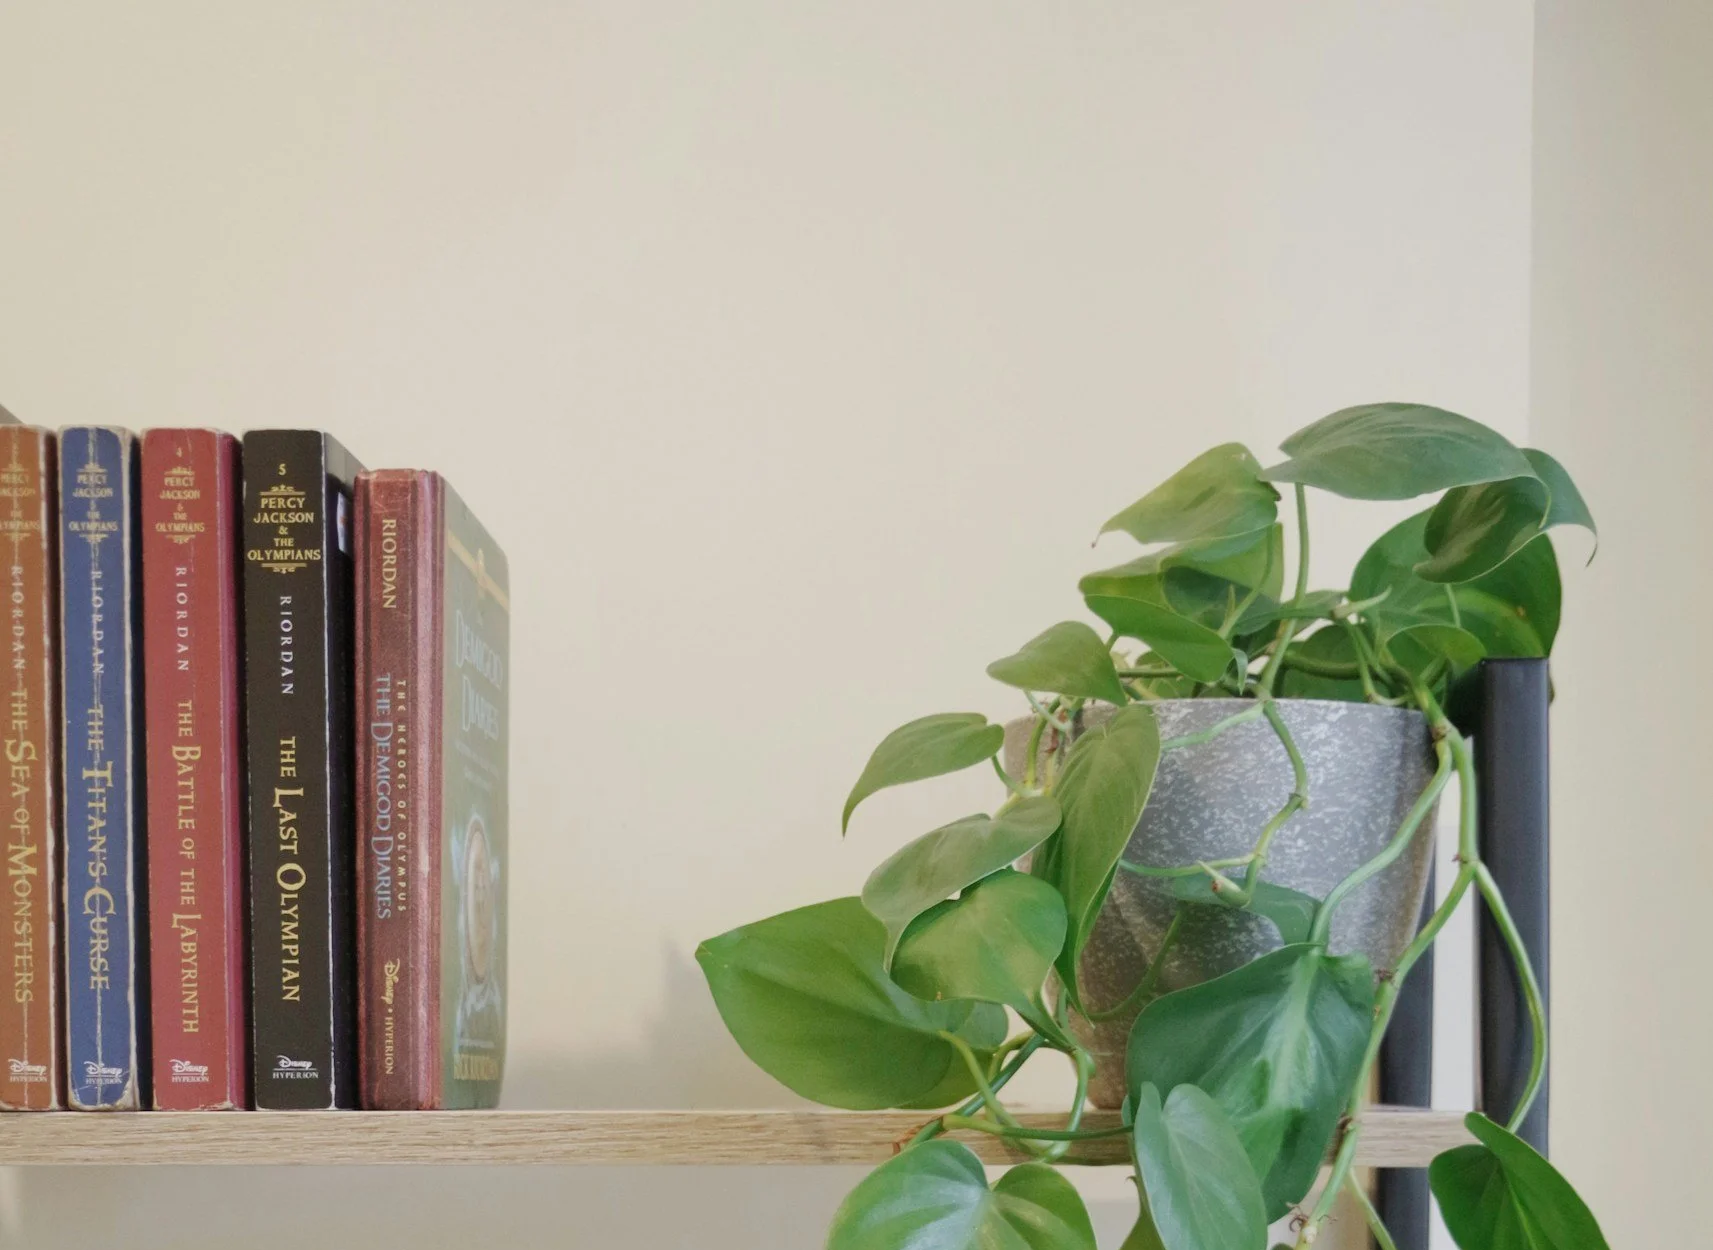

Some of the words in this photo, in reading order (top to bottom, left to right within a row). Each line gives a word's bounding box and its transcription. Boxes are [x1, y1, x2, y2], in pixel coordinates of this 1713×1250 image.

[160, 490, 200, 500] JACKSON
[164, 477, 194, 487] PERCY
[253, 512, 314, 523] JACKSON
[260, 497, 305, 509] PERCY
[69, 521, 118, 531] OLYMPIANS
[155, 522, 204, 532] OLYMPIANS
[274, 537, 294, 547] THE
[278, 525, 289, 535] &
[247, 550, 321, 561] OLYMPIANS
[382, 518, 397, 608] RIORDAN
[12, 566, 25, 669] RIORDAN
[92, 571, 104, 674] RIORDAN
[175, 567, 189, 671] RIORDAN
[279, 595, 293, 694] RIORDAN
[11, 688, 28, 730] THE
[376, 672, 391, 716] THE
[397, 680, 406, 711] THE
[87, 704, 104, 750] THE
[178, 700, 193, 737] THE
[5, 739, 38, 797] SEA
[280, 736, 296, 777] THE
[371, 722, 394, 831] DEMIGOD
[397, 725, 406, 790] HEROES
[172, 745, 201, 830] BATTLE
[10, 808, 30, 834] OF
[82, 761, 114, 876] TITAN'S
[273, 787, 304, 855] LAST
[397, 801, 406, 820] OF
[180, 837, 194, 860] OF
[180, 868, 195, 905] THE
[371, 836, 394, 919] DIARIES
[397, 832, 407, 912] OLYMPUS
[8, 843, 37, 1002] MONSTERS
[83, 886, 117, 990] CURSE
[276, 862, 307, 1002] OLYMPIAN
[171, 913, 202, 1033] LABYRINTH
[381, 958, 400, 1004] Disney
[276, 1055, 312, 1069] Disney
[384, 1017, 394, 1075] HYPERION
[8, 1059, 47, 1075] Disney
[84, 1061, 122, 1079] Disney
[170, 1059, 208, 1075] Disney
[172, 1075, 209, 1083] HYPERION
[273, 1071, 319, 1079] HYPERION
